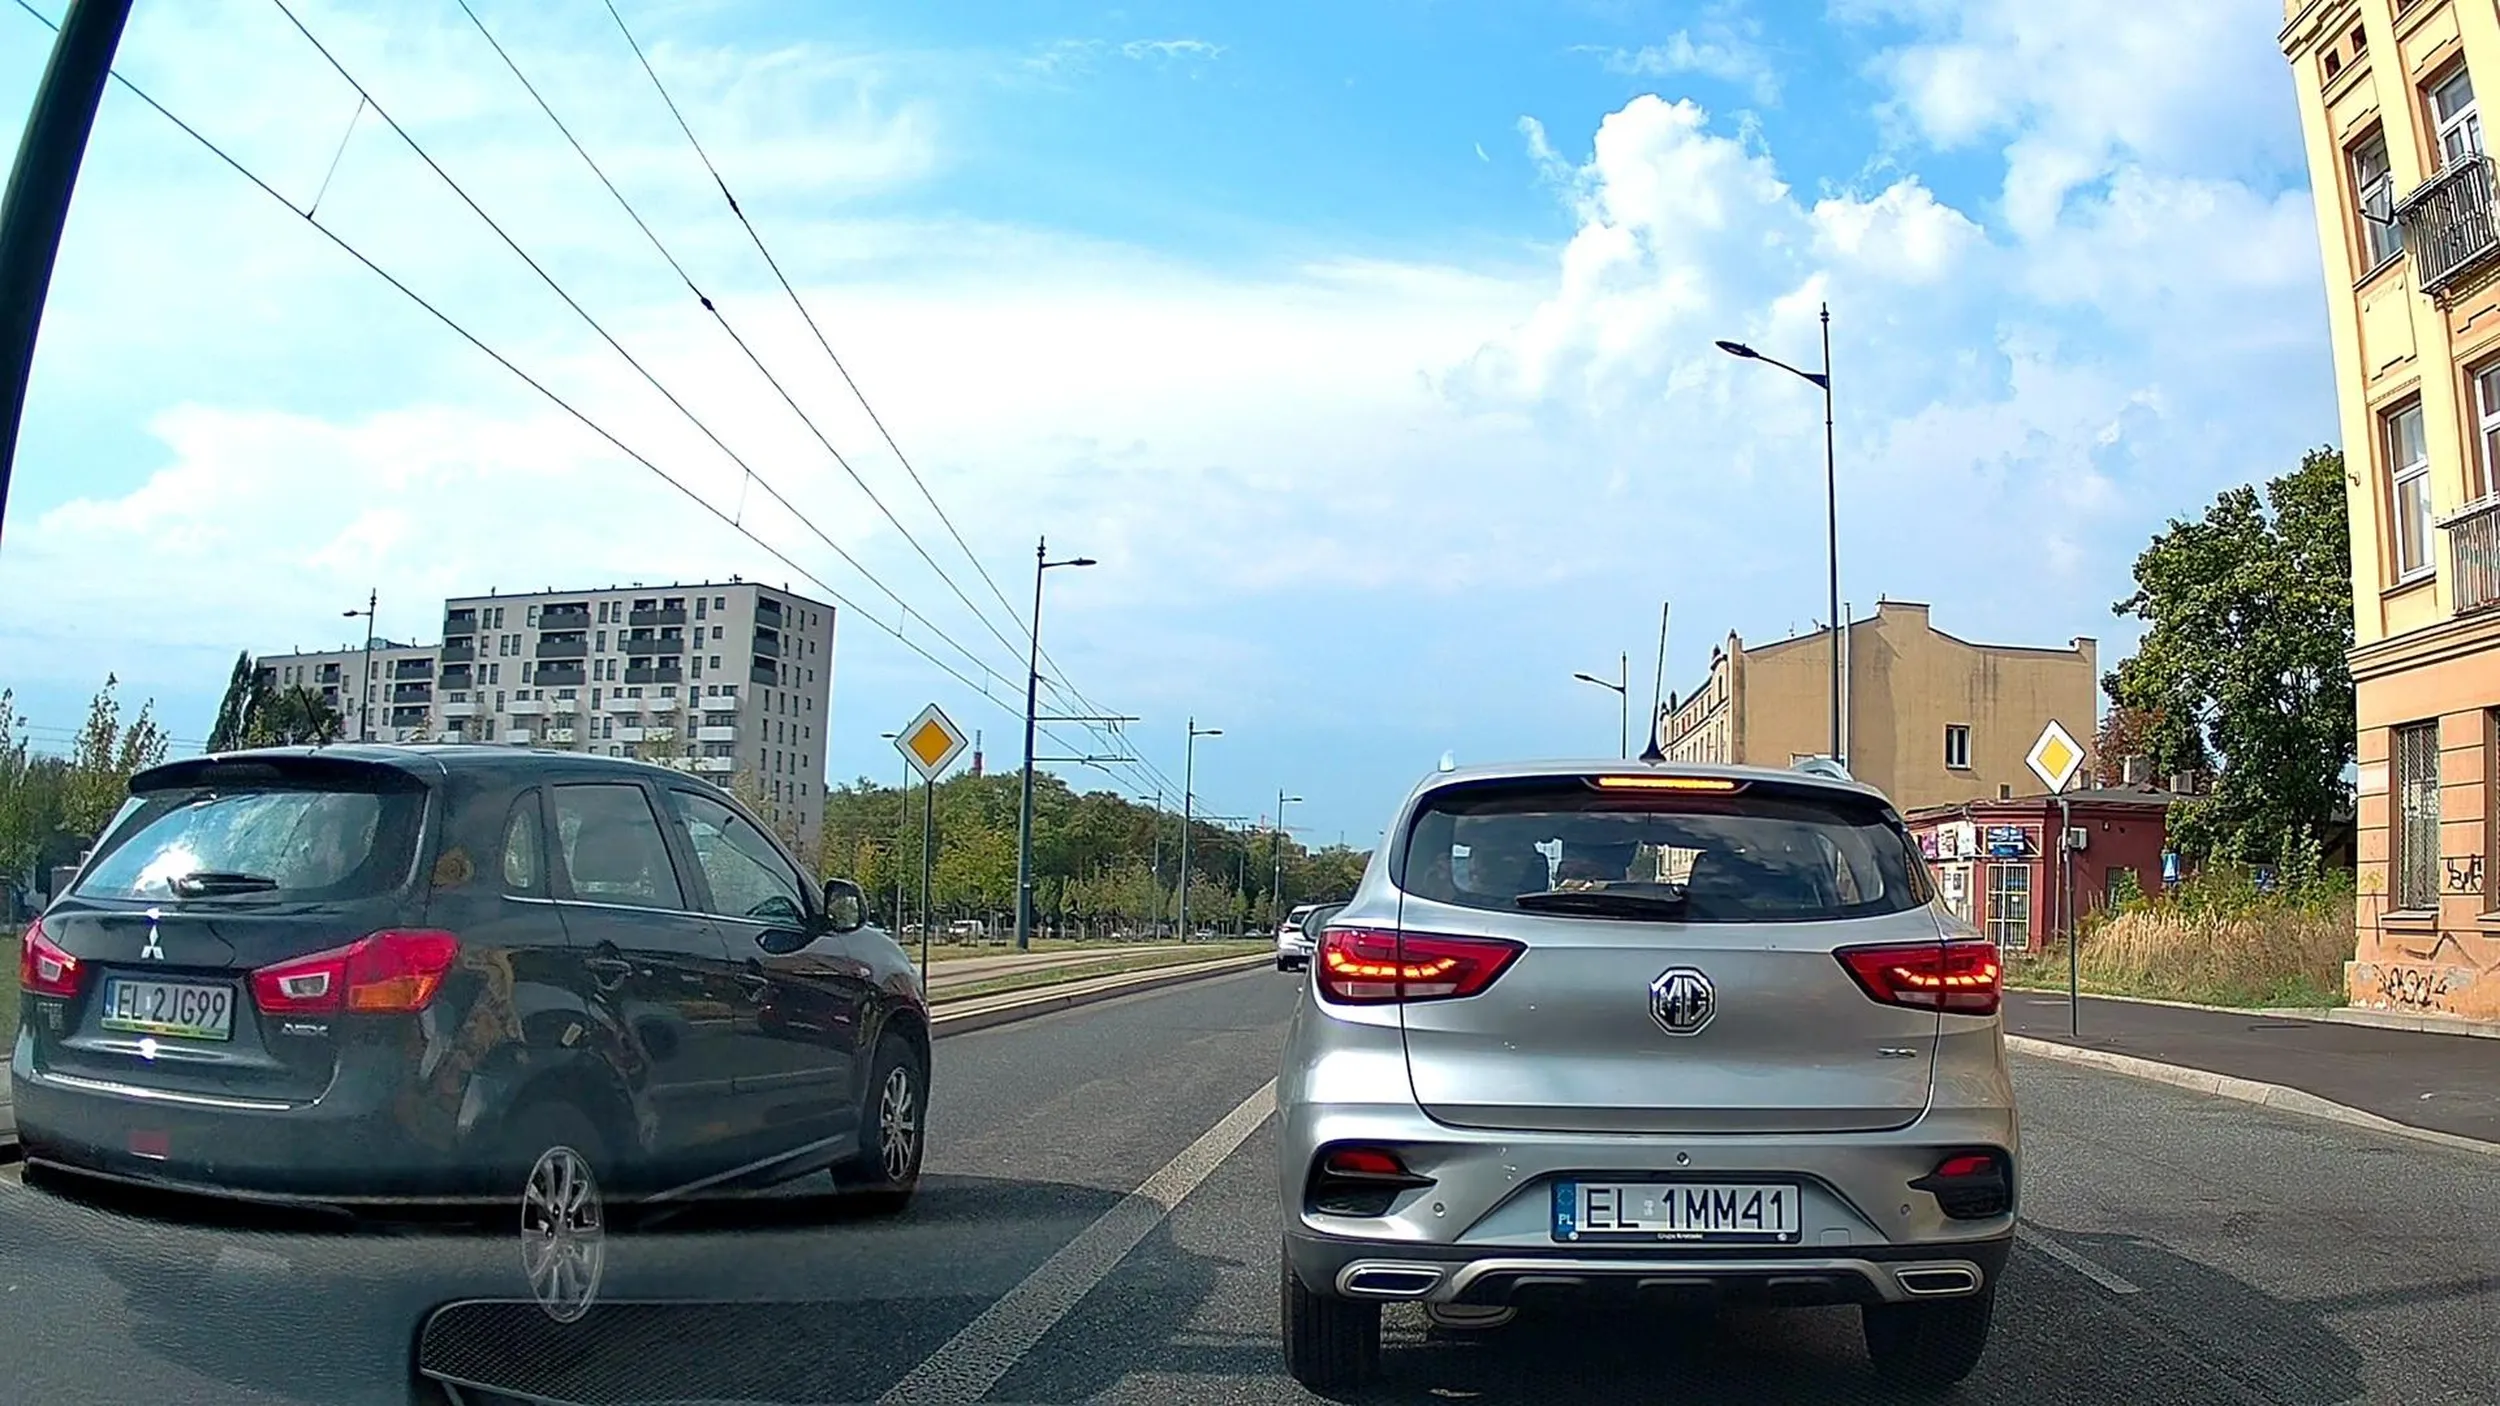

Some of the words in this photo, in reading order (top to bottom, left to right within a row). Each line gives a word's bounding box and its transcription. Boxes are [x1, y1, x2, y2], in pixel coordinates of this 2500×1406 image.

[117, 983, 143, 1020] EL
[151, 986, 226, 1029] 2JG99
[1656, 972, 1709, 1029] MG
[1558, 1213, 1574, 1226] PL
[1586, 1188, 1640, 1229] EL
[1661, 1188, 1783, 1230] 1MM41
